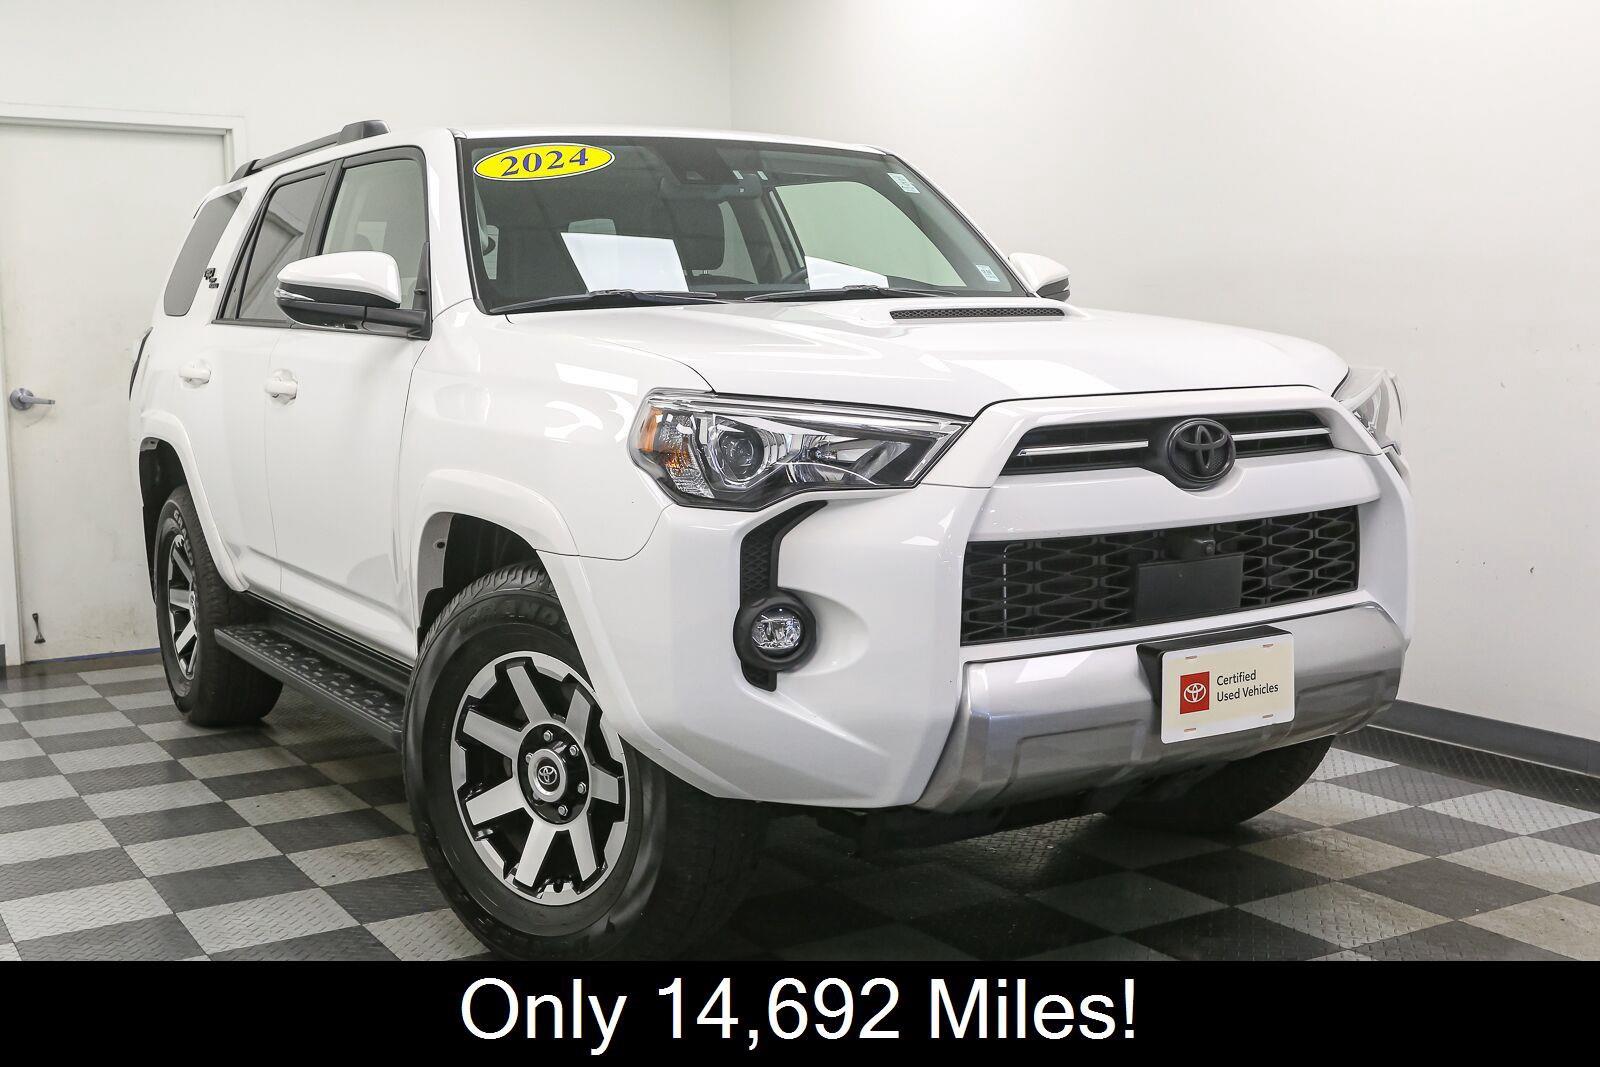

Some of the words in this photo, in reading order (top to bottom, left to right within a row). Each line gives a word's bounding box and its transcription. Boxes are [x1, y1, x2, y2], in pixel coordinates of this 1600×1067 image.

[500, 147, 589, 177] 2024
[1216, 669, 1257, 686] Certified
[1216, 688, 1240, 702] Used
[1242, 683, 1279, 698] Vehicles
